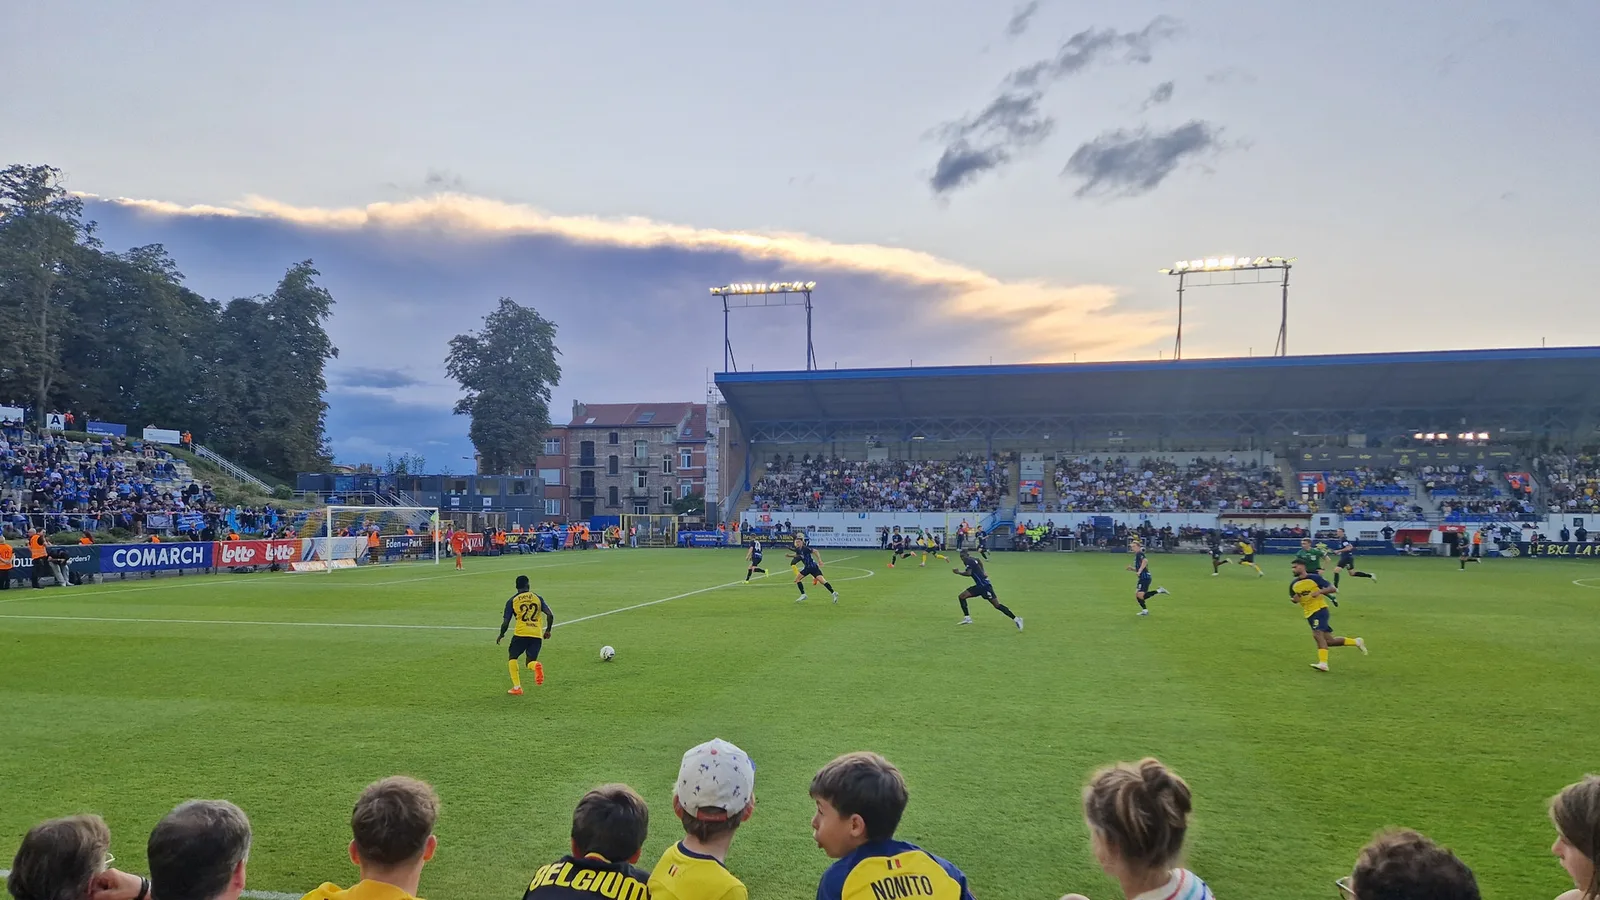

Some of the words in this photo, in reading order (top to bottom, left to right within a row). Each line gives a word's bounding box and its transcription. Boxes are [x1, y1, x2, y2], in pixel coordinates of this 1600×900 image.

[50, 415, 60, 424] A
[386, 539, 401, 548] Eden
[409, 538, 423, 547] Park
[1547, 544, 1570, 555] BXL
[1574, 544, 1592, 555] LA
[112, 546, 204, 568] COMARCH
[519, 602, 539, 622] 22
[529, 861, 649, 900] BELGIUM
[870, 875, 934, 900] NONITO
